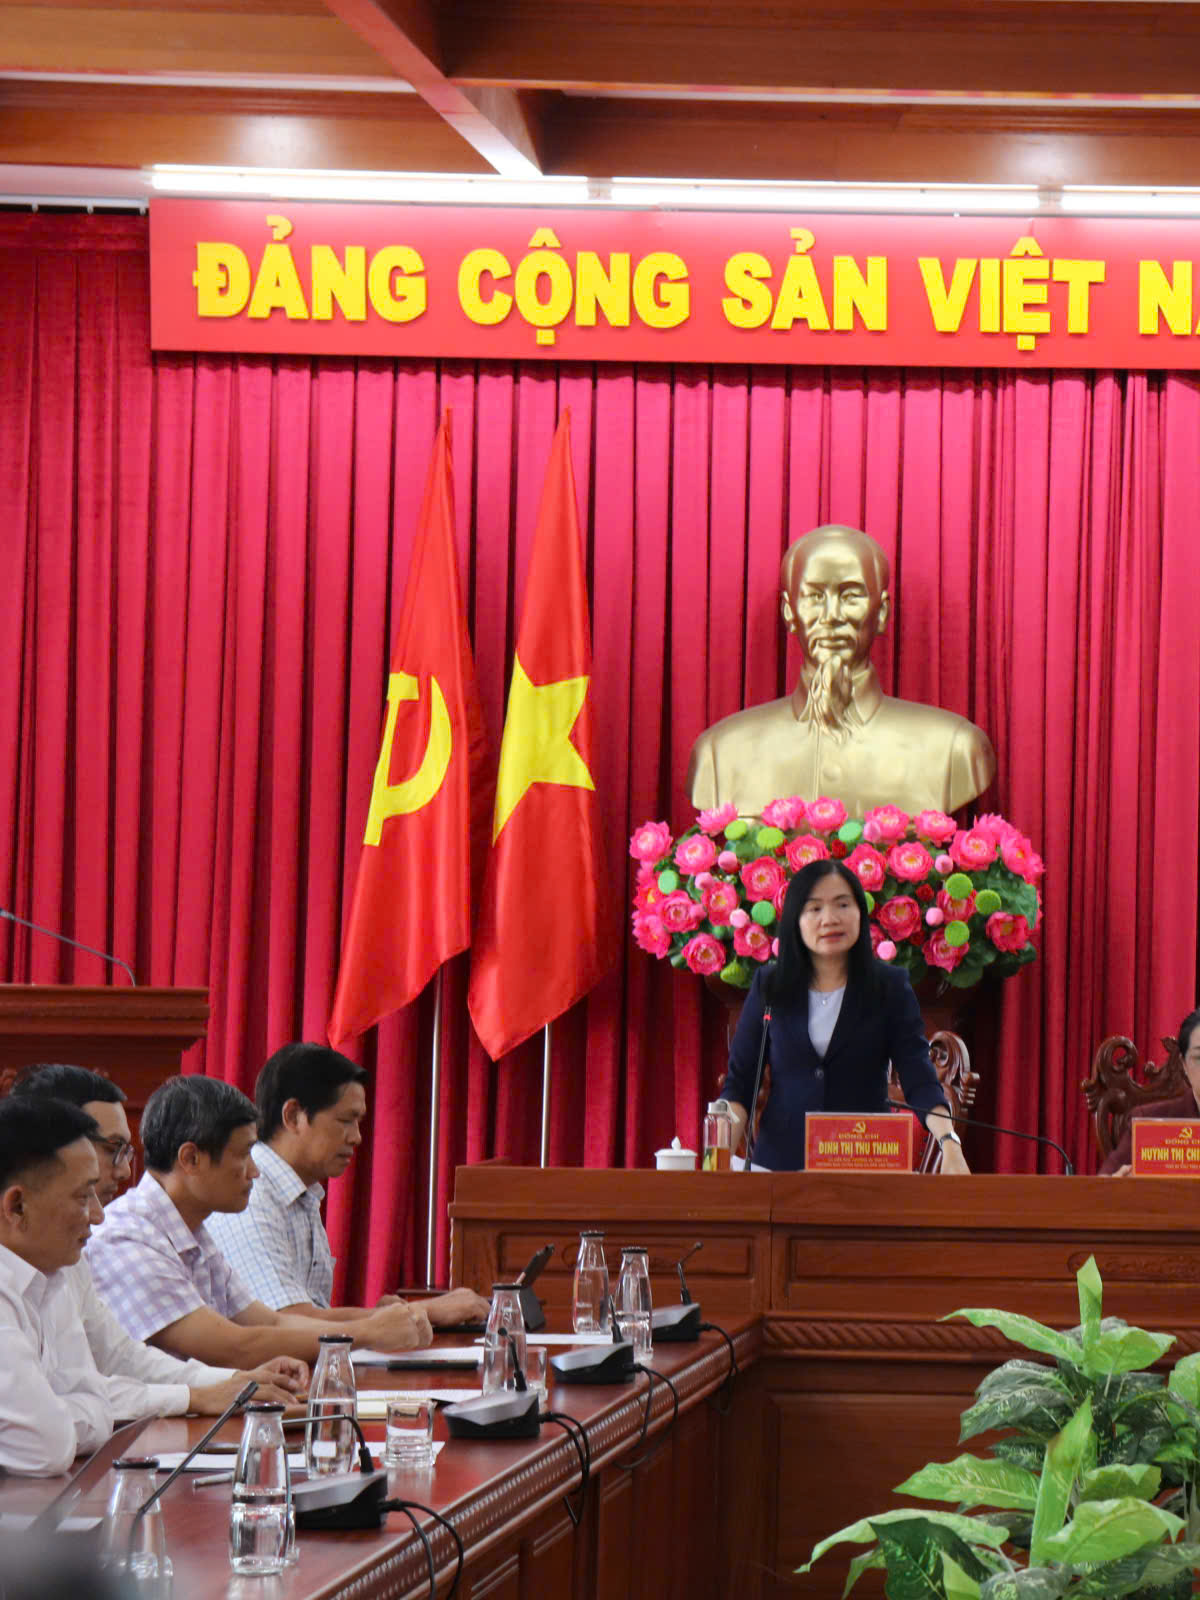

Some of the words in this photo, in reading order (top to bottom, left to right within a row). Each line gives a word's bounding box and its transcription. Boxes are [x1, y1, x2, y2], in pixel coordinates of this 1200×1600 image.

[193, 213, 427, 323] ĐẢNG
[458, 228, 690, 345] CỘNG
[722, 226, 888, 332] SẢN
[918, 236, 1106, 350] VIỆT
[855, 1141, 871, 1156] THU
[873, 1142, 899, 1156] THANH
